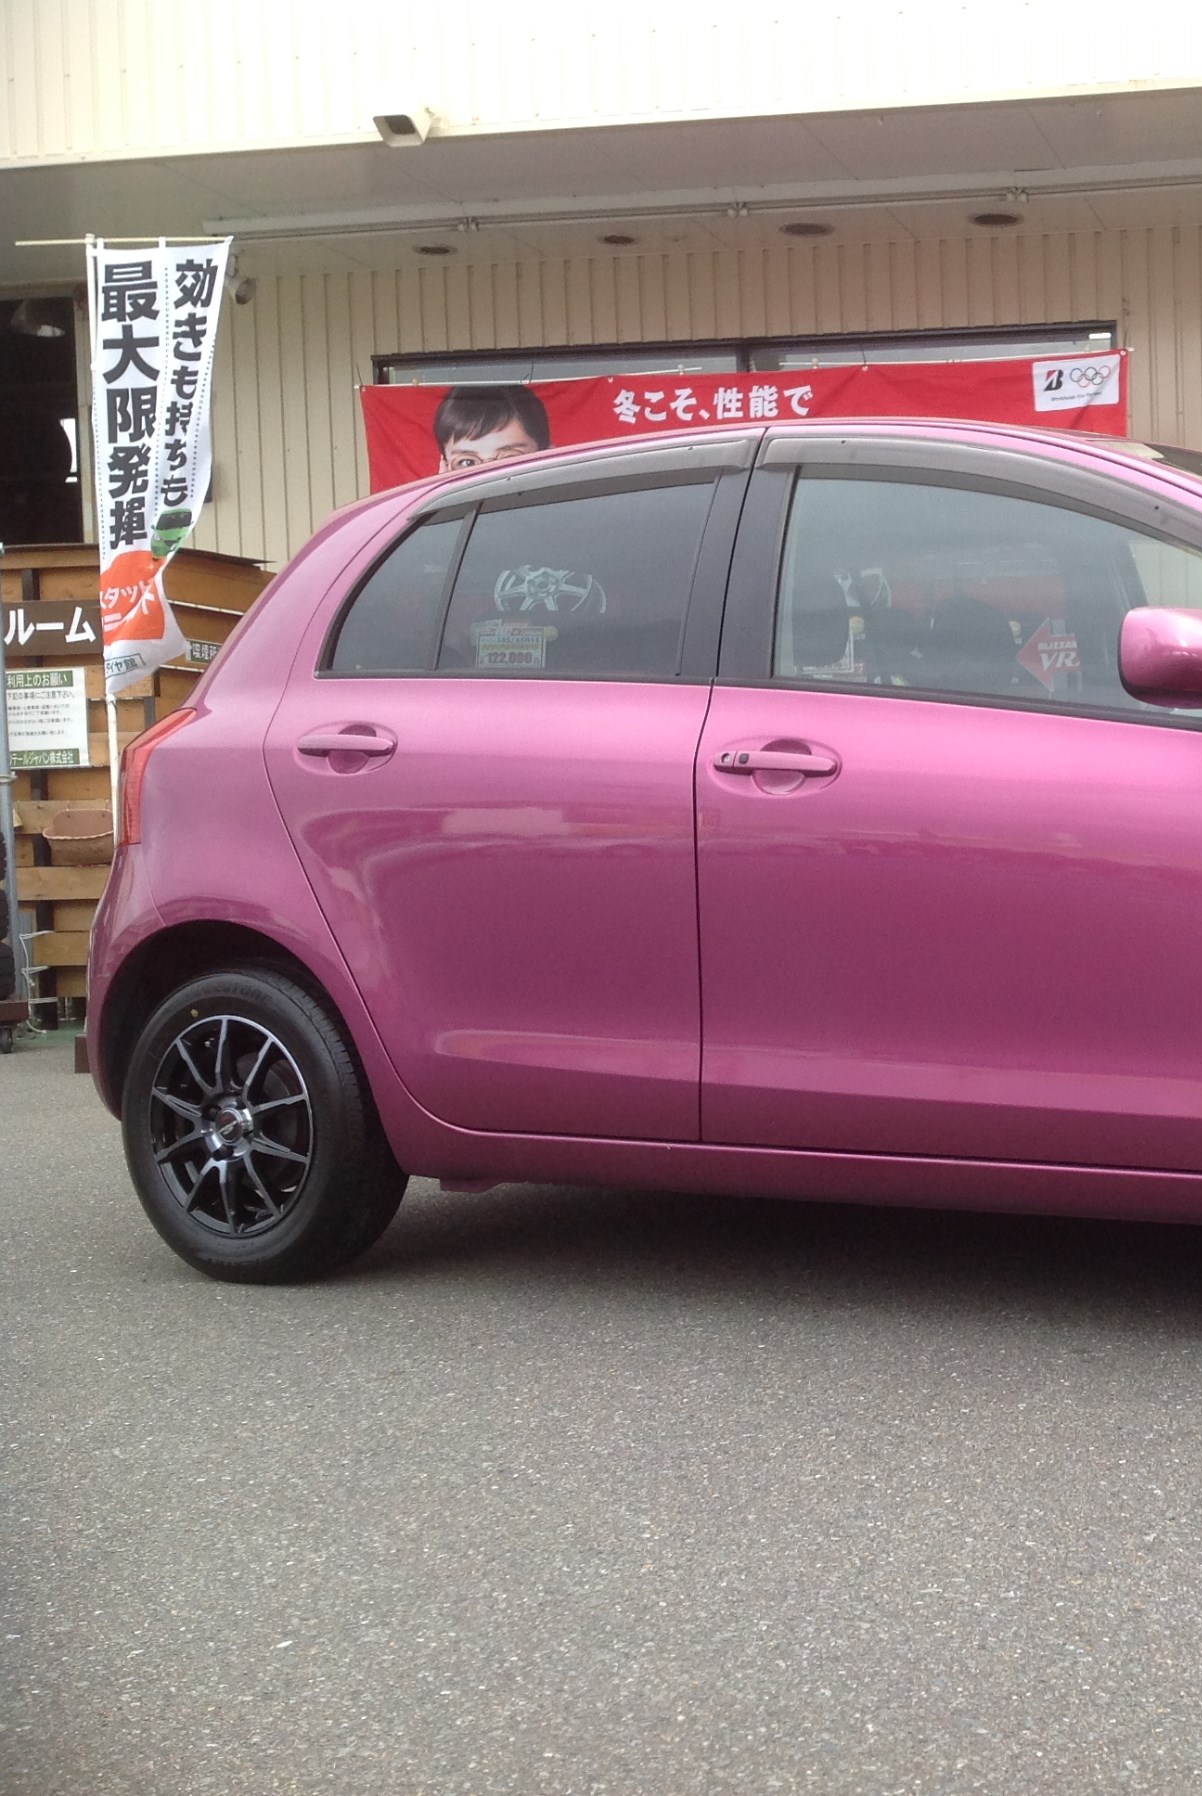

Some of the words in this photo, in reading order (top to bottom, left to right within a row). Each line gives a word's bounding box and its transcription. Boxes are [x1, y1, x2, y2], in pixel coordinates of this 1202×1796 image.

[101, 260, 160, 549] 最大限発揮
[160, 258, 218, 506] 効きも持ちも
[613, 384, 814, 424] 冬こそ、性能で
[4, 606, 96, 645] ルーム
